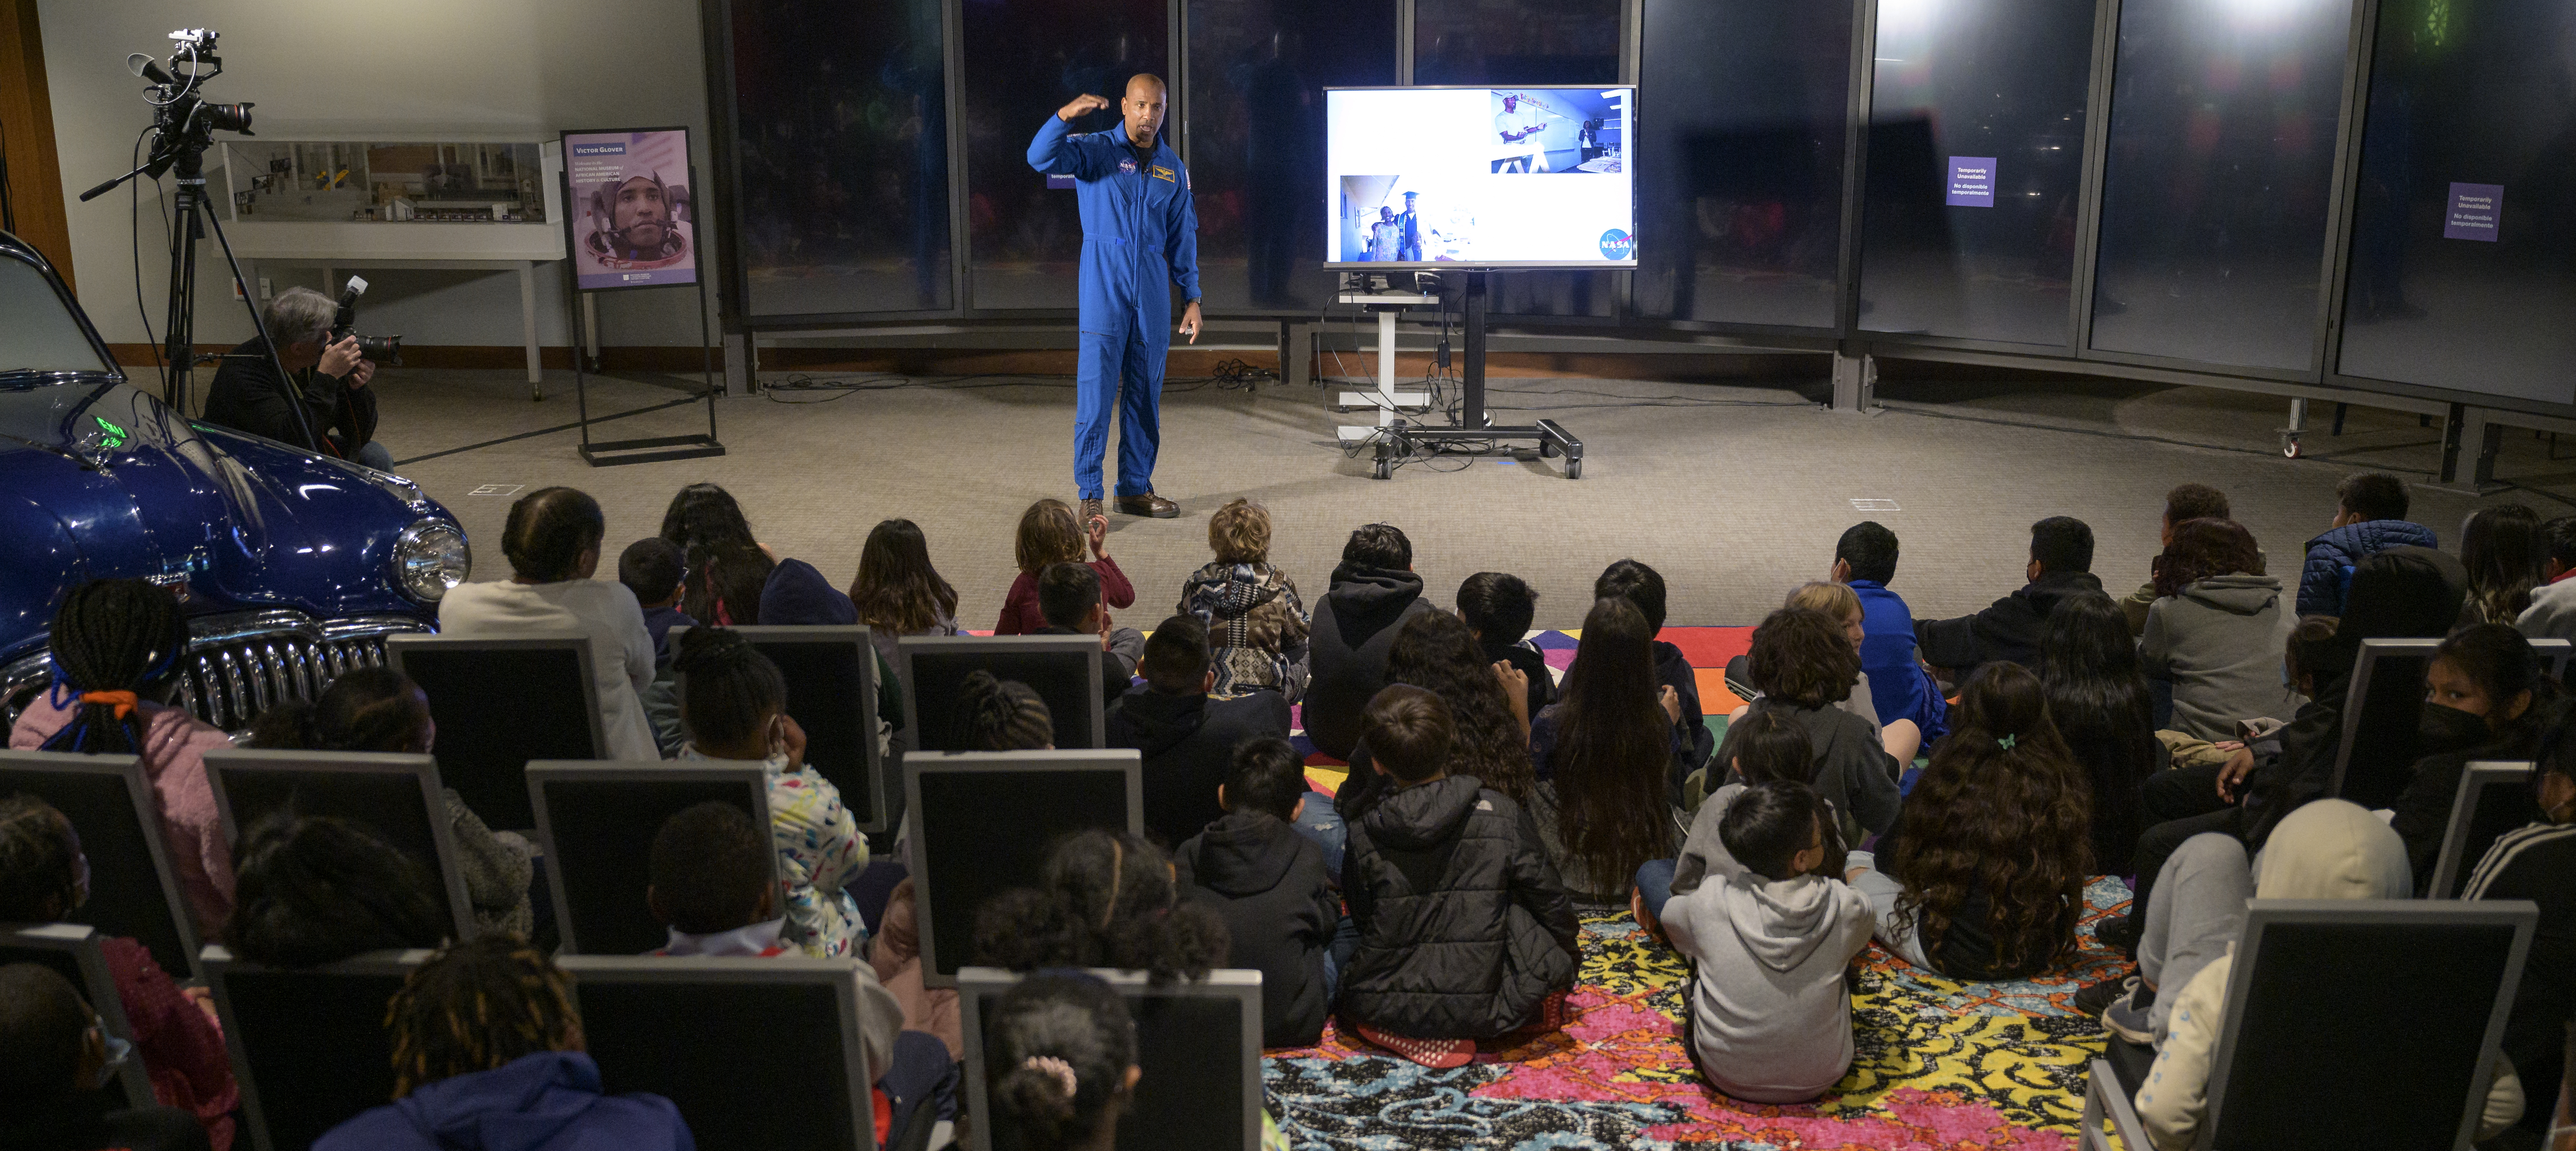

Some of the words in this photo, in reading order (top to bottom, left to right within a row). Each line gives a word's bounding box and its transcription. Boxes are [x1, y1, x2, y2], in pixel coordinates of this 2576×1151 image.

[1120, 162, 1136, 171] NASA
[2459, 195, 2492, 204] Temporarily
[2451, 220, 2493, 228] temporalmente
